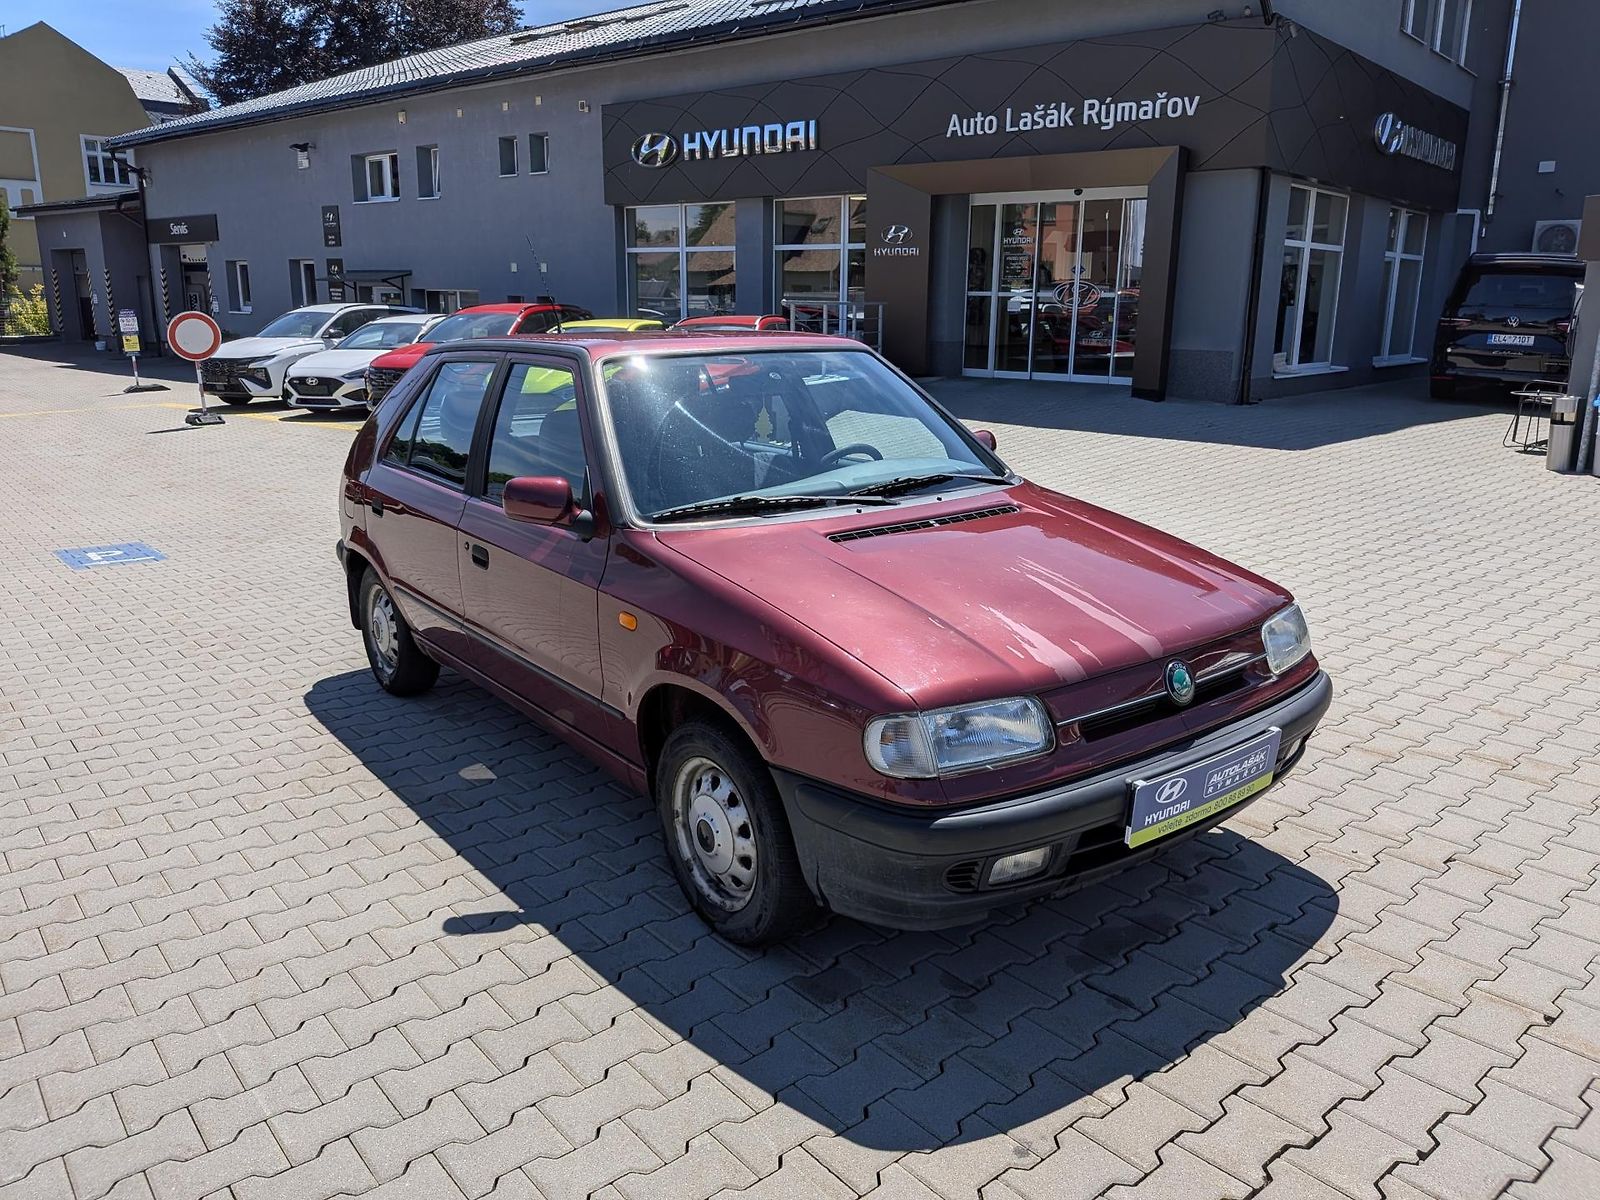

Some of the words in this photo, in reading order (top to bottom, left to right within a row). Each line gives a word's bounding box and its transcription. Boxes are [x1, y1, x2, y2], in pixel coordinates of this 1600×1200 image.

[946, 112, 997, 138] Auto
[1005, 102, 1074, 132] Lašák
[1082, 92, 1201, 131] Rýmařov
[683, 119, 817, 161] HYUNDAI
[873, 247, 920, 257] HYUNDAI
[1003, 237, 1033, 245] HYUNDAI
[1208, 750, 1267, 784] AUTOLAŠÁK
[1144, 799, 1191, 826] HYUNDAI
[1157, 818, 1183, 834] volejte
[1184, 805, 1212, 825] zdarma
[1213, 796, 1228, 811] 800
